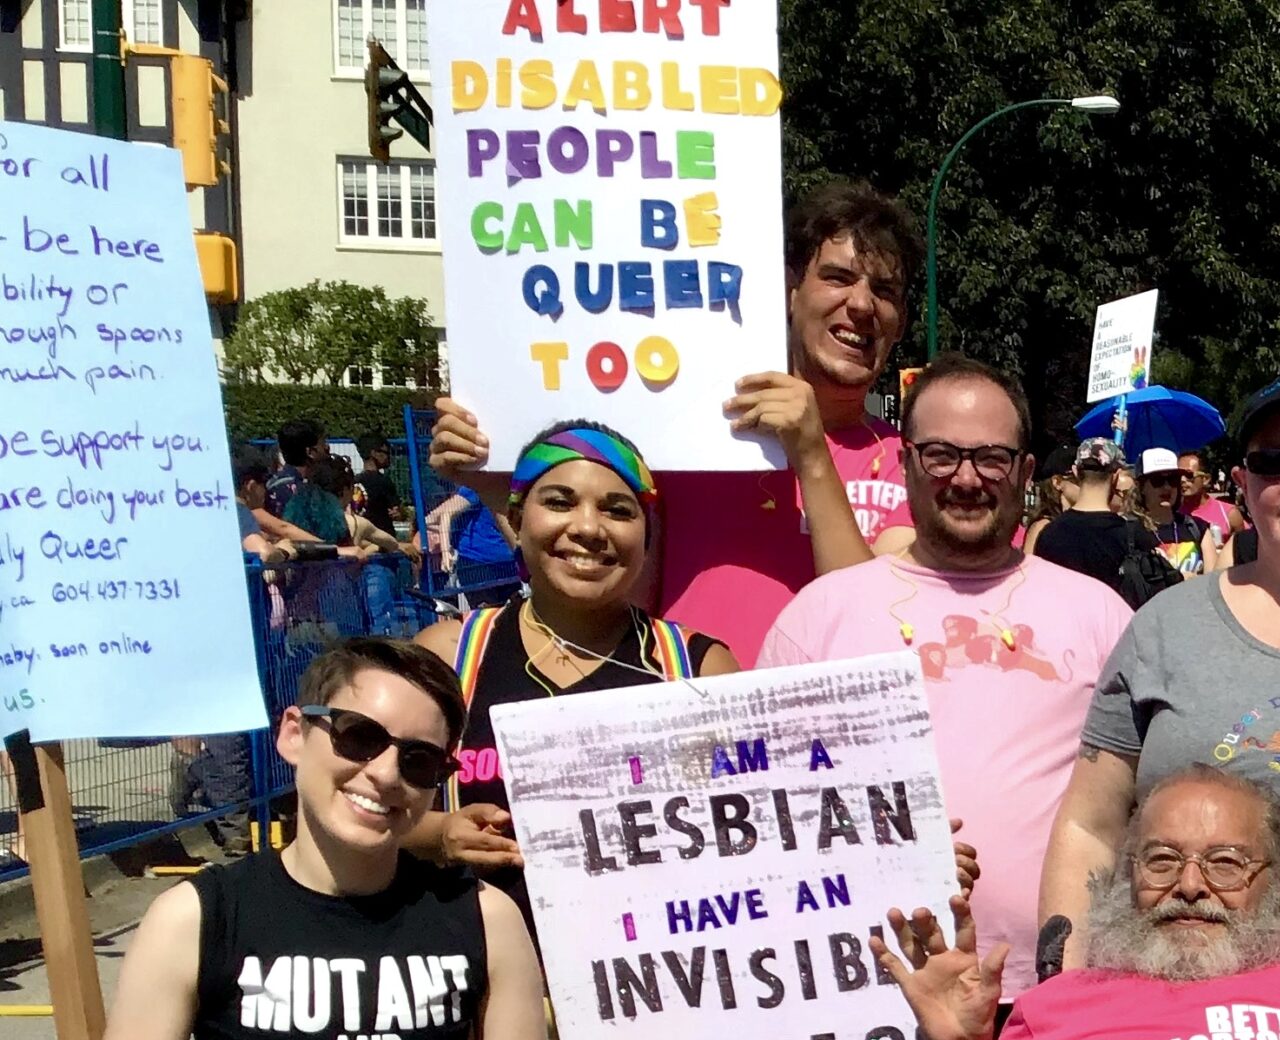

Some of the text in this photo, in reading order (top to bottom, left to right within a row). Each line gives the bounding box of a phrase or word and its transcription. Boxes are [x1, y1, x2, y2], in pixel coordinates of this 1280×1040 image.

[502, 0, 731, 42] ALERT
[451, 58, 783, 116] DISABLED
[61, 153, 109, 192] all
[466, 125, 717, 185] PEOPLE
[23, 215, 164, 263] be here
[471, 192, 722, 254] CAN BE
[87, 283, 128, 304] or
[522, 260, 743, 325] QUEER
[96, 323, 182, 354] spoons
[1094, 344, 1132, 361] EXPECTATION
[1095, 332, 1134, 351] REASONABLE
[530, 335, 680, 392] TOO
[1091, 377, 1128, 394] SEXUALITY
[41, 420, 145, 470] support
[56, 476, 115, 525] doing
[122, 489, 165, 521] your
[40, 530, 128, 564] Queer
[51, 642, 88, 658] soon
[99, 632, 152, 655] online
[711, 738, 770, 779] AM
[809, 738, 835, 772] A
[579, 780, 918, 876] LESBIAN
[622, 873, 852, 942] I HAVE AN
[238, 954, 470, 1033] MUTANT
